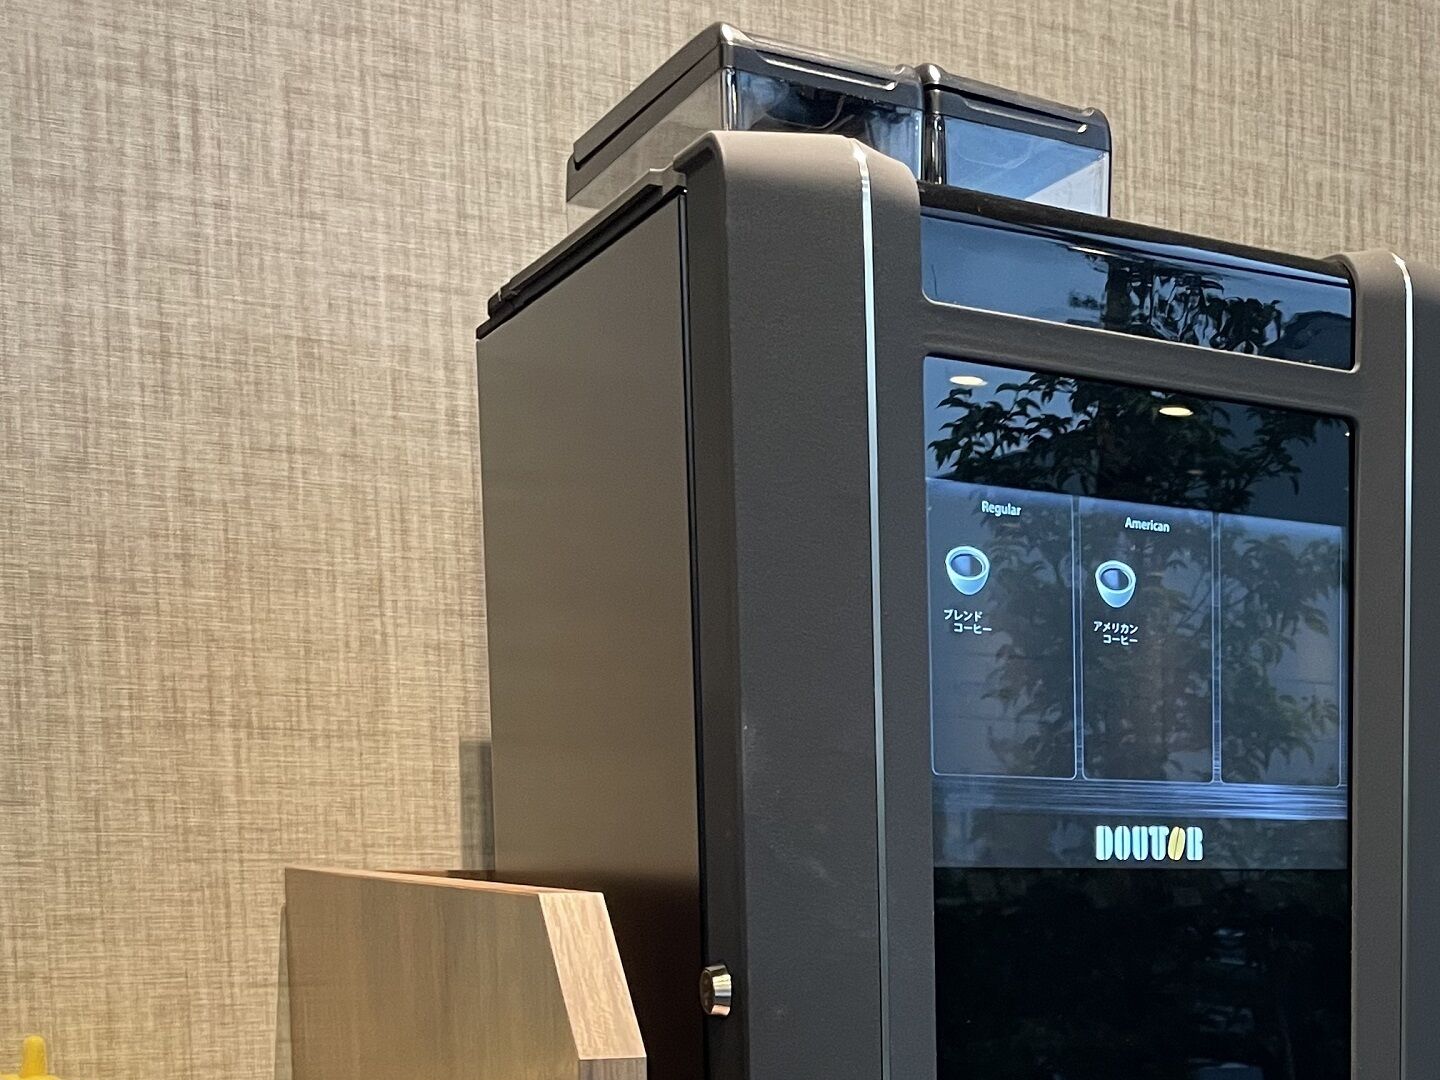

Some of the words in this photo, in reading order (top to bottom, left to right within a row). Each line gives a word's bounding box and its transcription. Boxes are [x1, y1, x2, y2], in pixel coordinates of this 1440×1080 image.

[981, 500, 1021, 517] Regular
[1124, 516, 1170, 533] American
[943, 608, 983, 622] ブレンド
[953, 622, 993, 635] コーヒー
[1093, 620, 1139, 635] アメリカン
[1102, 634, 1139, 646] コーヒー
[1095, 825, 1204, 861] DOUTOR
